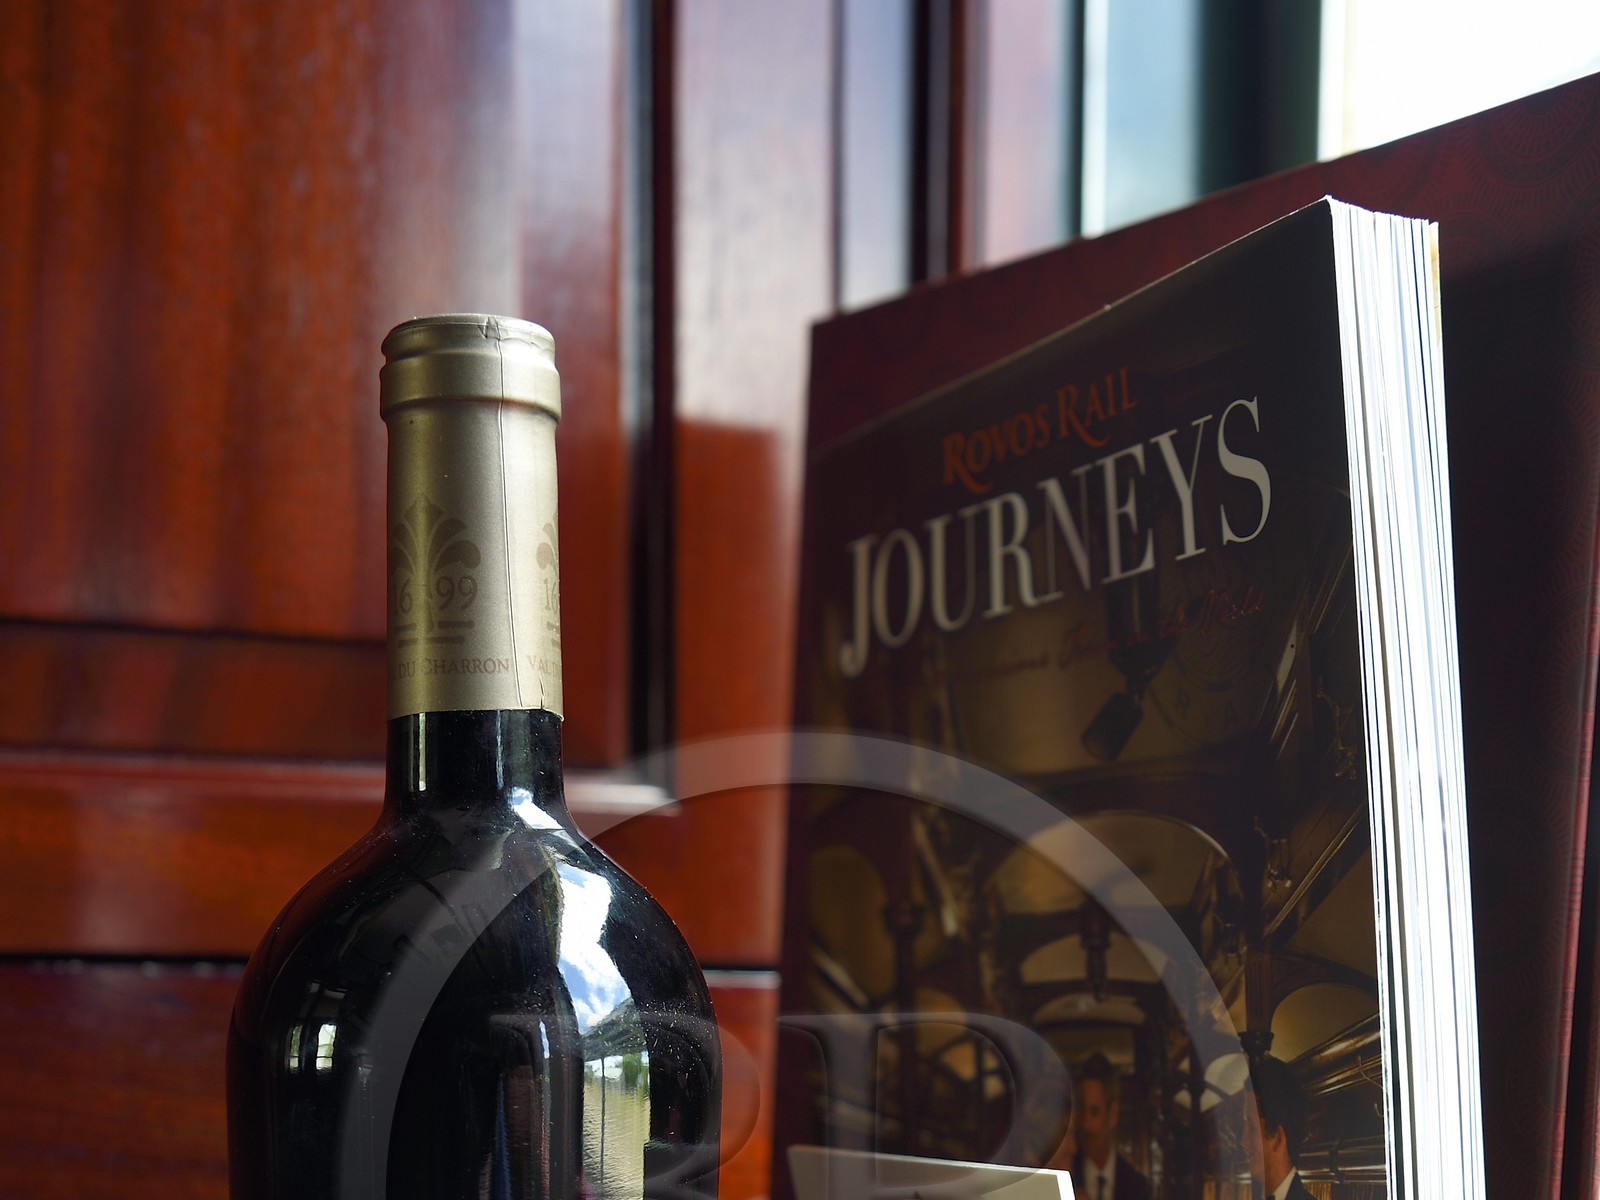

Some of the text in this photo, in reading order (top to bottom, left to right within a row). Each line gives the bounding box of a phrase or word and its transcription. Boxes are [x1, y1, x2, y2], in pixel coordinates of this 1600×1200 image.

[943, 367, 1137, 494] ROVOS RAIL
[840, 396, 1272, 678] JOURNEYS
